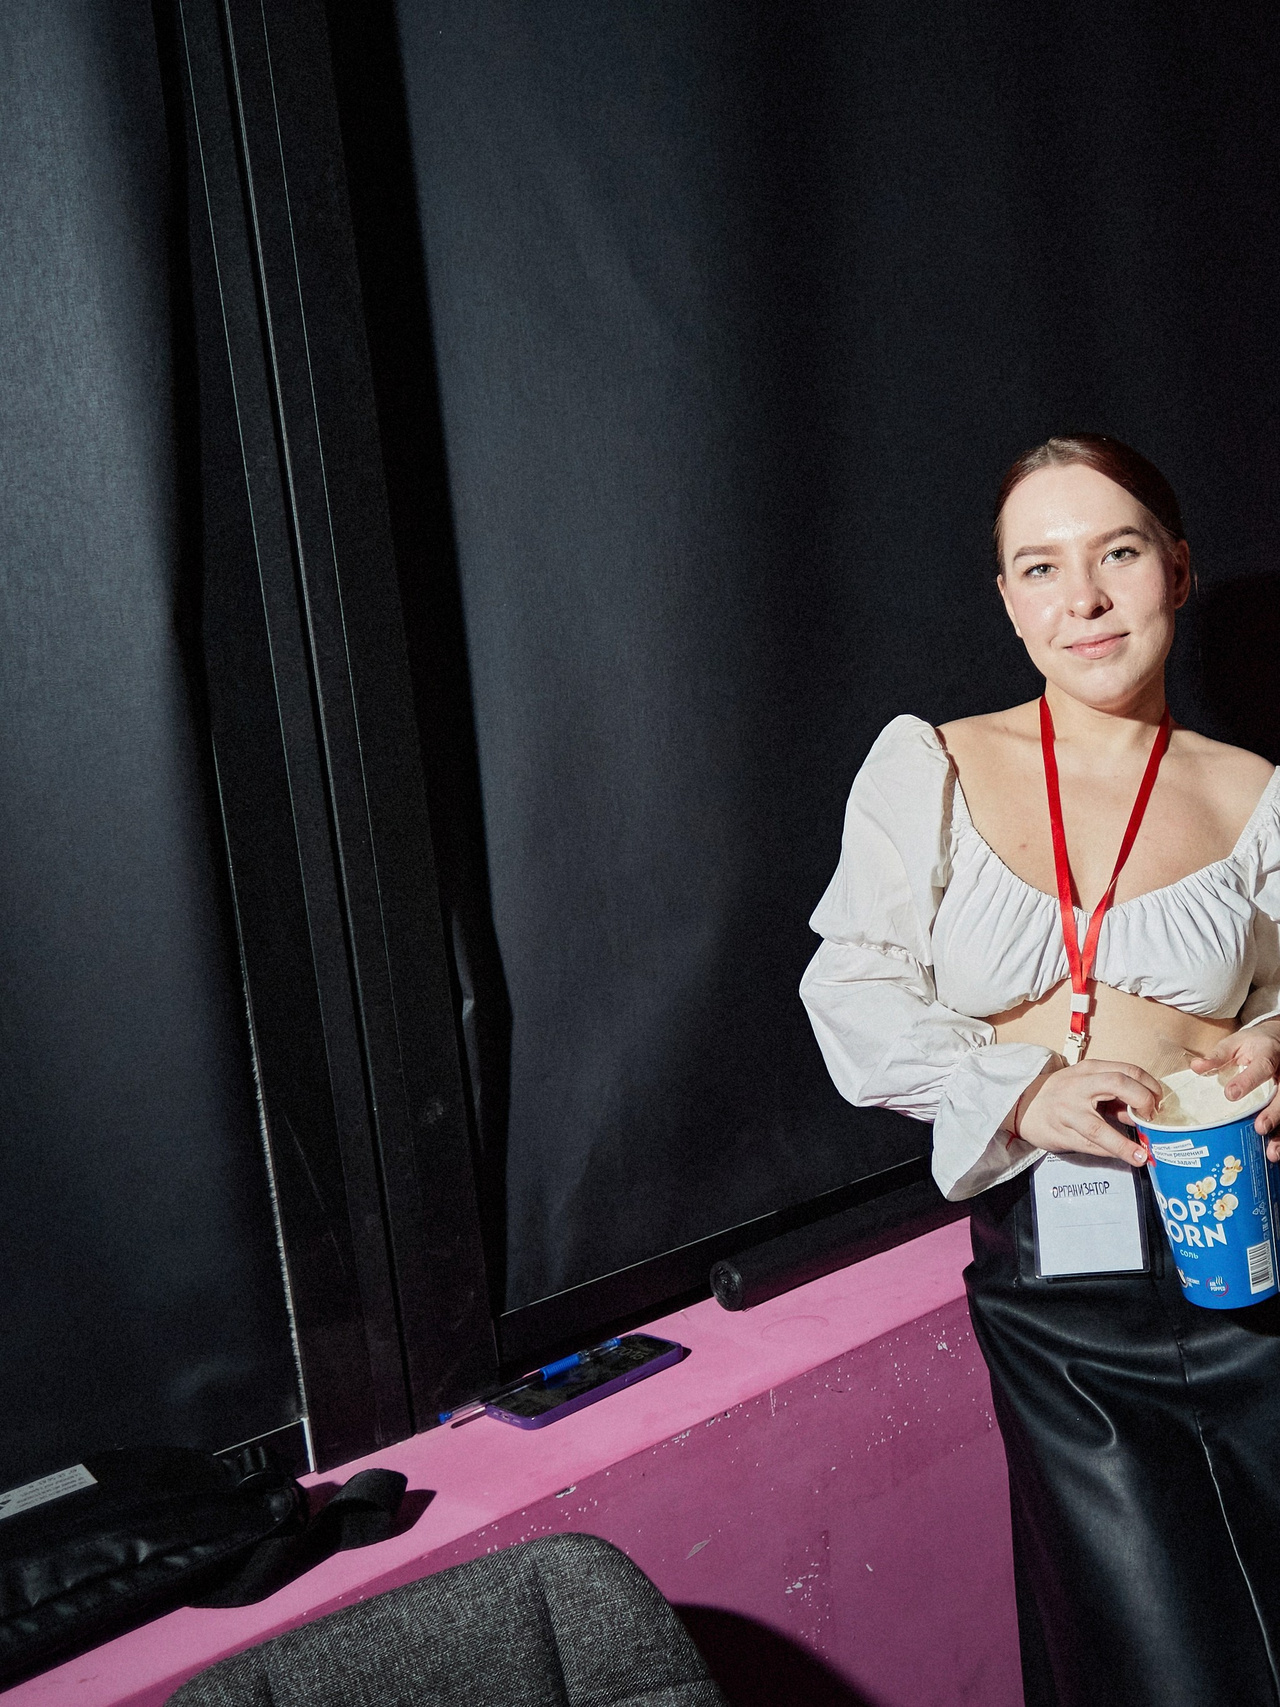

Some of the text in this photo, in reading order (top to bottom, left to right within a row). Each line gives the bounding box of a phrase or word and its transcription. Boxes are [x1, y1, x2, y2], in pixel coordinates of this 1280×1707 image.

[1052, 1180, 1110, 1199] ОРГАНИЗАТОР
[1162, 1213, 1228, 1248] ORN
[1180, 1249, 1199, 1259] соль
